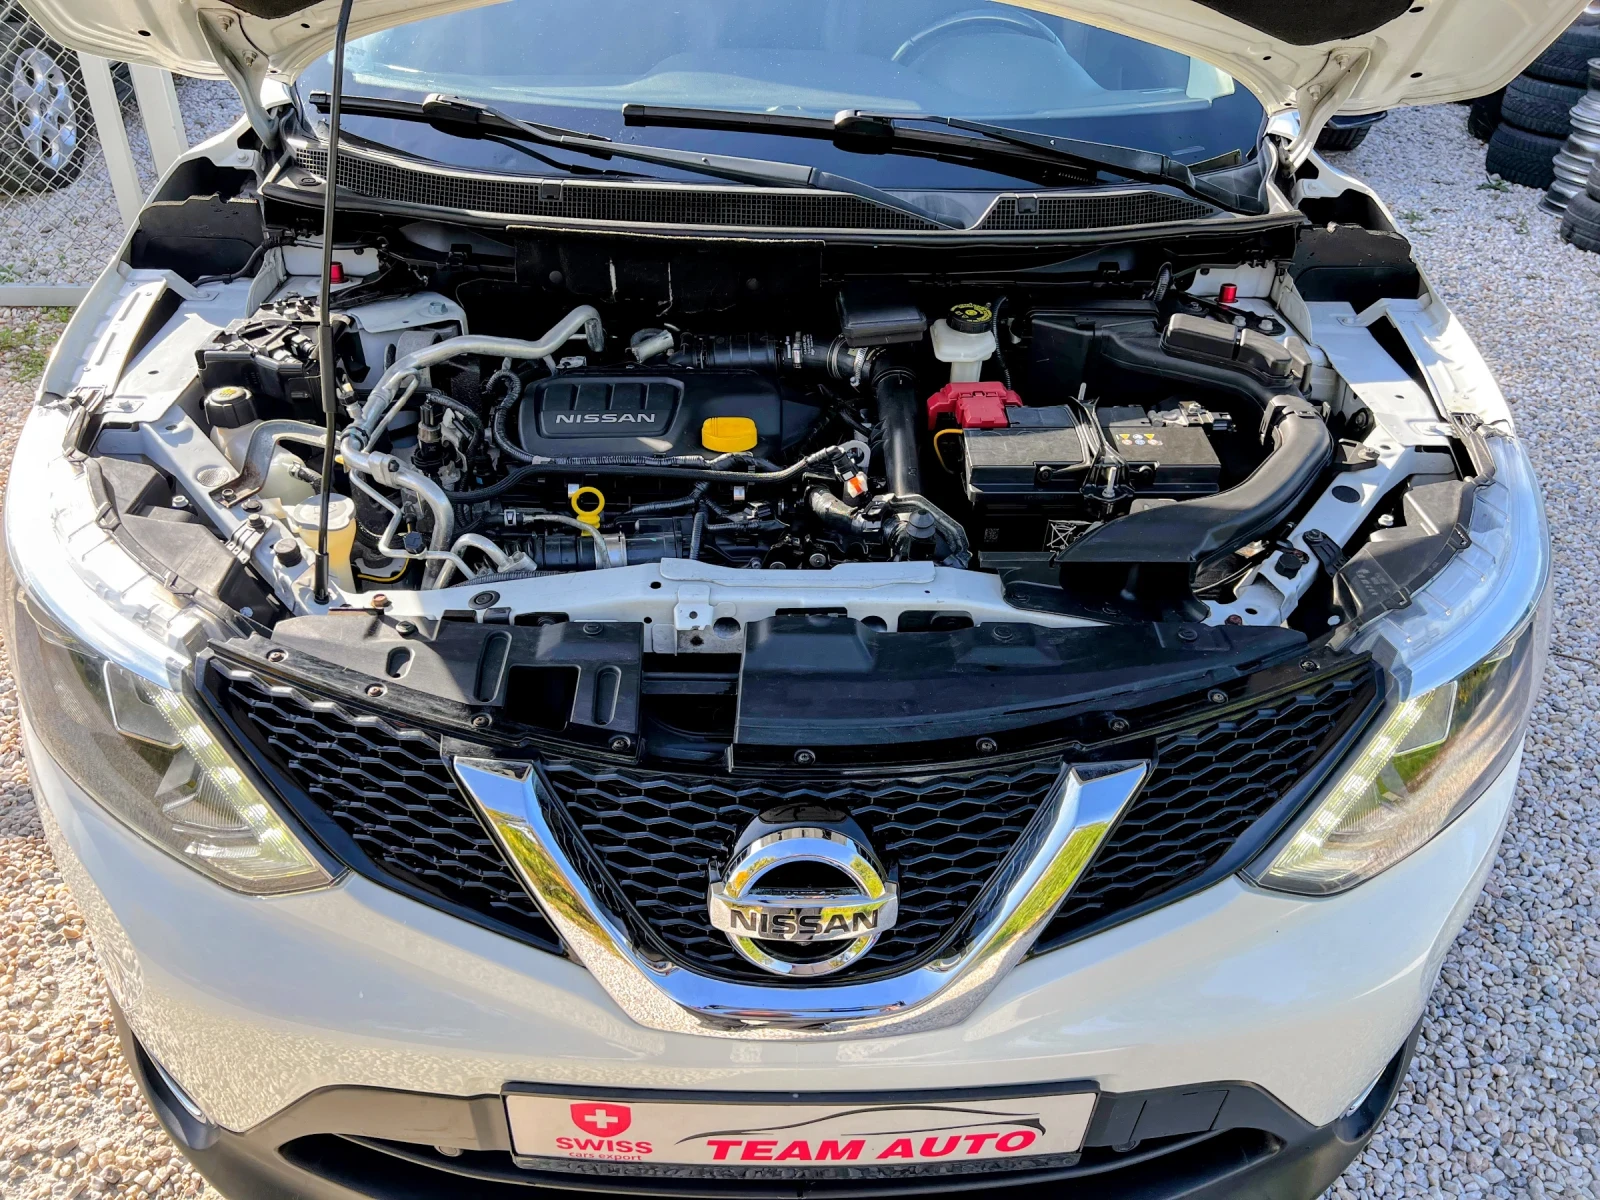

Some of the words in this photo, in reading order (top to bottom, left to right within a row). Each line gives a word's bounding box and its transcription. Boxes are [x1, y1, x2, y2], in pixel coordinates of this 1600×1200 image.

[555, 413, 656, 424] NISSAN
[730, 909, 879, 935] NISSAN
[555, 1137, 653, 1155] SWISS
[706, 1139, 866, 1161] TEAM
[876, 1130, 1037, 1160] AUTO
[568, 1151, 595, 1159] cars
[598, 1153, 642, 1161] export
